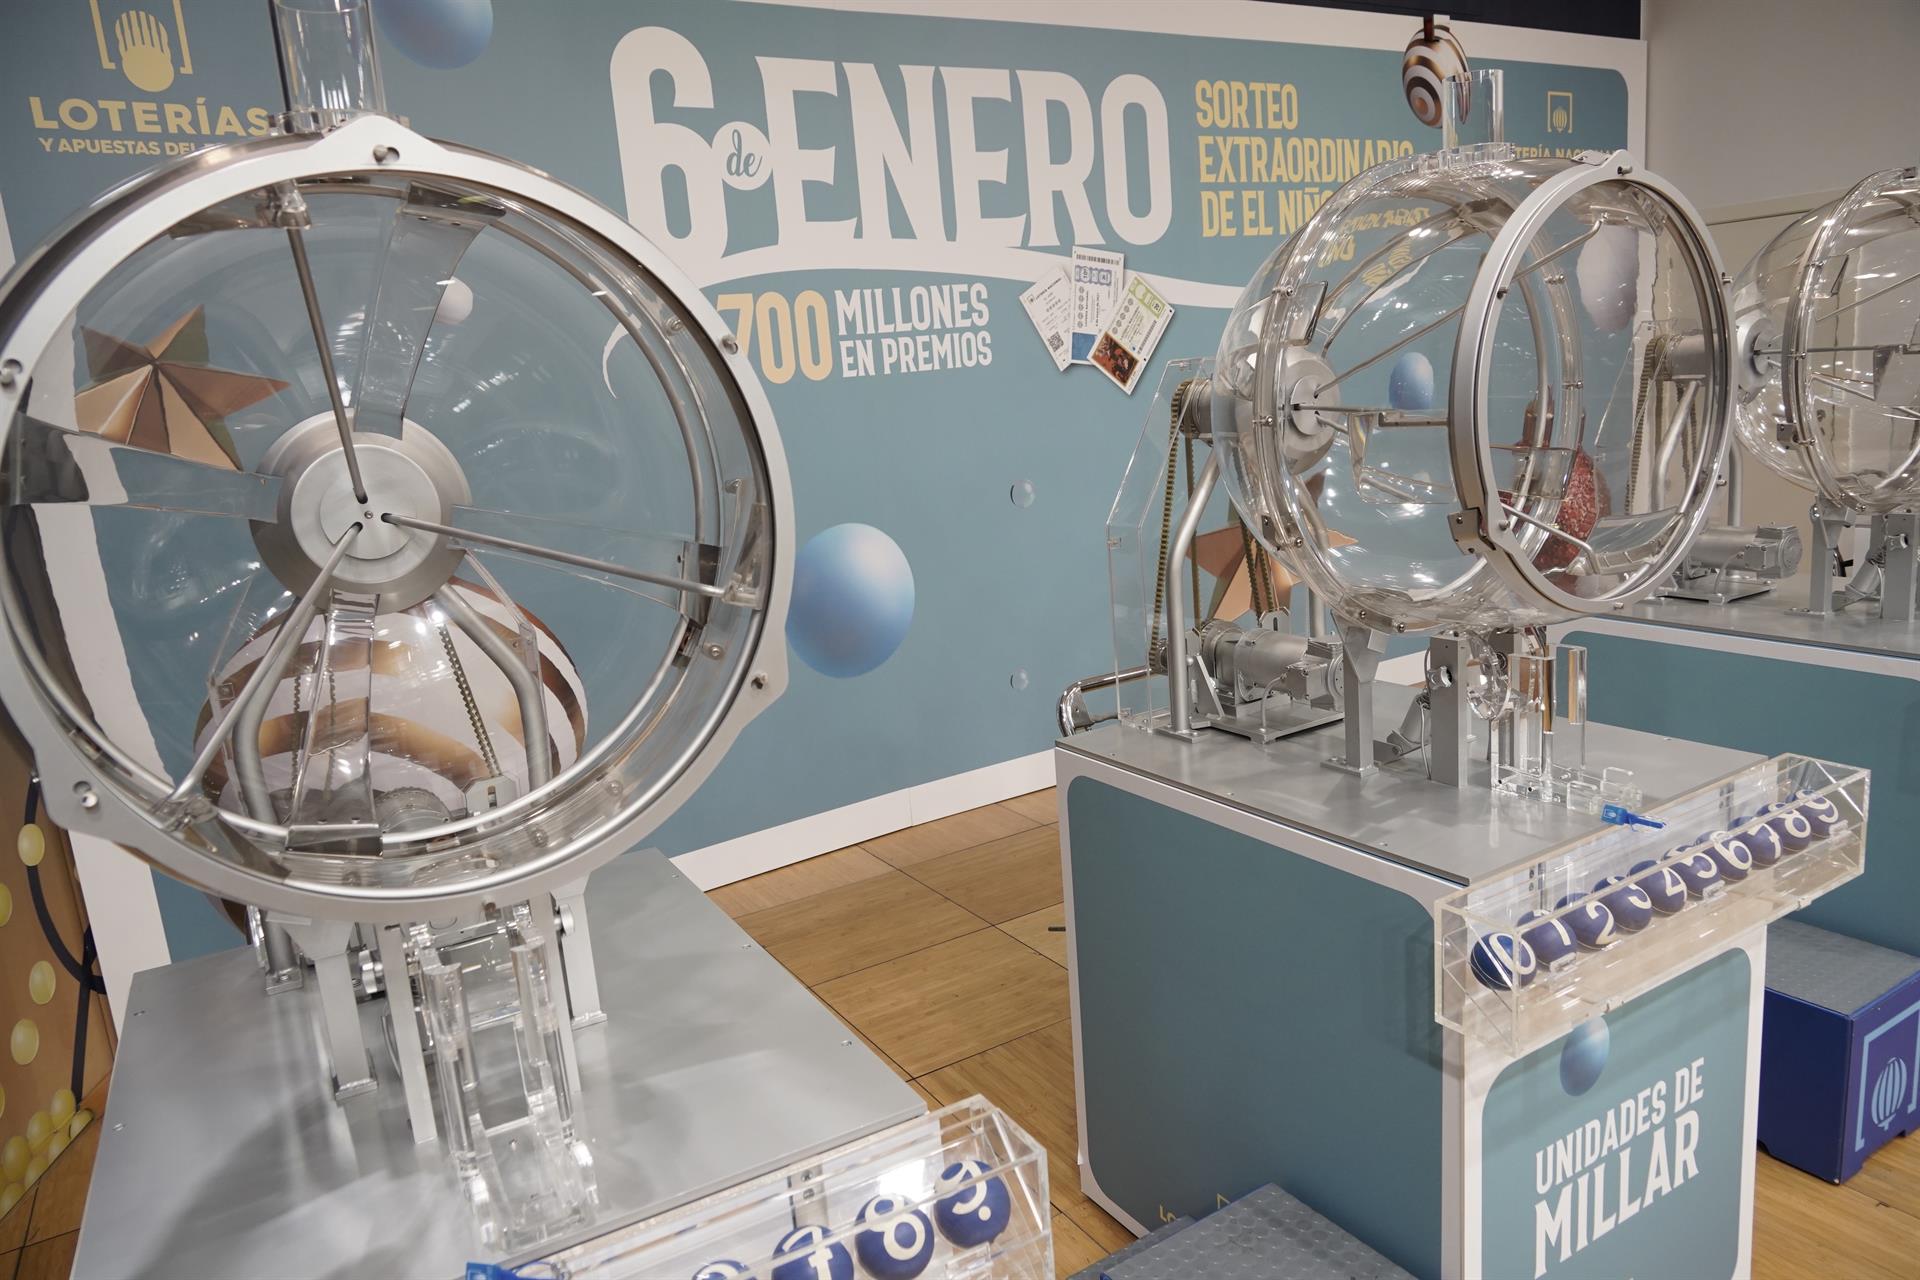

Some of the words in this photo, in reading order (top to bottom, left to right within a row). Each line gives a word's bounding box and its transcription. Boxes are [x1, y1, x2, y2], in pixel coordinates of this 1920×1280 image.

[29, 96, 269, 136] LOTERÍAS
[1195, 80, 1298, 130] SORTEO
[39, 137, 53, 152] Y
[58, 138, 161, 155] APUESTAS
[610, 26, 728, 258] 6
[726, 129, 762, 177] de
[755, 56, 1173, 248] ENERO
[1201, 190, 1237, 237] DE
[1242, 190, 1273, 235] EL
[716, 290, 833, 384] 700
[834, 283, 989, 335] MILLONES
[839, 339, 875, 377] EN
[881, 331, 992, 375] PREMIOS
[1586, 901, 1616, 944] 2
[1710, 831, 1752, 870] 6
[1768, 803, 1811, 838] 8
[1796, 790, 1839, 823] 9
[1536, 1080, 1667, 1194] UNIDADES
[1673, 1057, 1704, 1113] DE
[865, 1193, 926, 1260] 8
[1534, 1110, 1699, 1280] MILLAR
